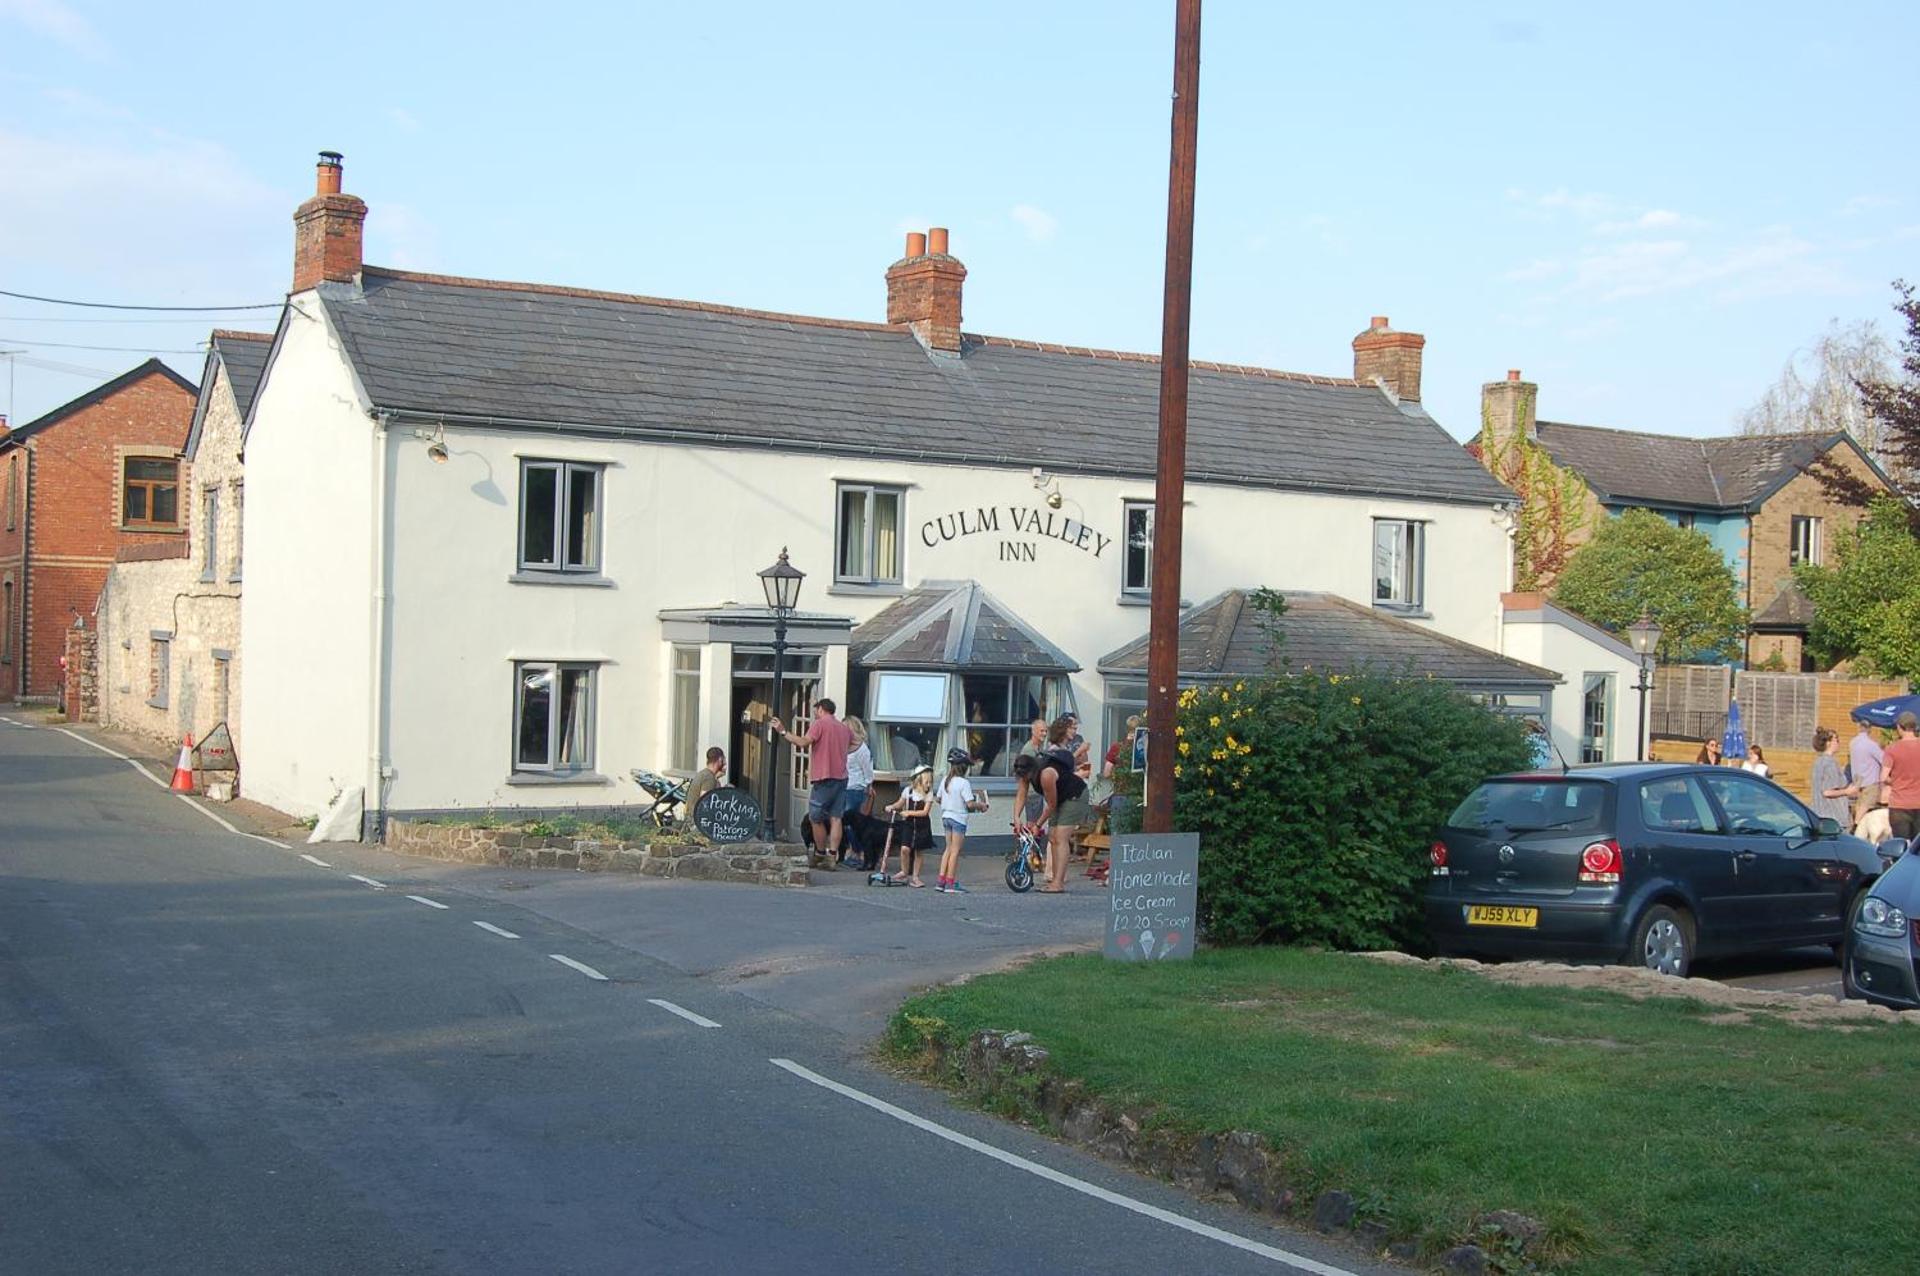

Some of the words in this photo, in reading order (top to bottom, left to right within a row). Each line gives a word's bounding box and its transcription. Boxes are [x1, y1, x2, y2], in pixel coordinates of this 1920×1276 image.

[921, 506, 1000, 548] CULM
[1009, 507, 1112, 558] VALLEY
[998, 541, 1036, 562] INN
[709, 793, 754, 818] Parking
[713, 822, 749, 836] Patrons
[715, 811, 740, 826] Only
[1121, 842, 1173, 863] Italian
[1112, 869, 1193, 891] Homemade
[1111, 893, 1133, 912] Ice
[1135, 894, 1176, 911] Cream
[1473, 906, 1504, 921] WJ59
[1506, 907, 1531, 923] XLY
